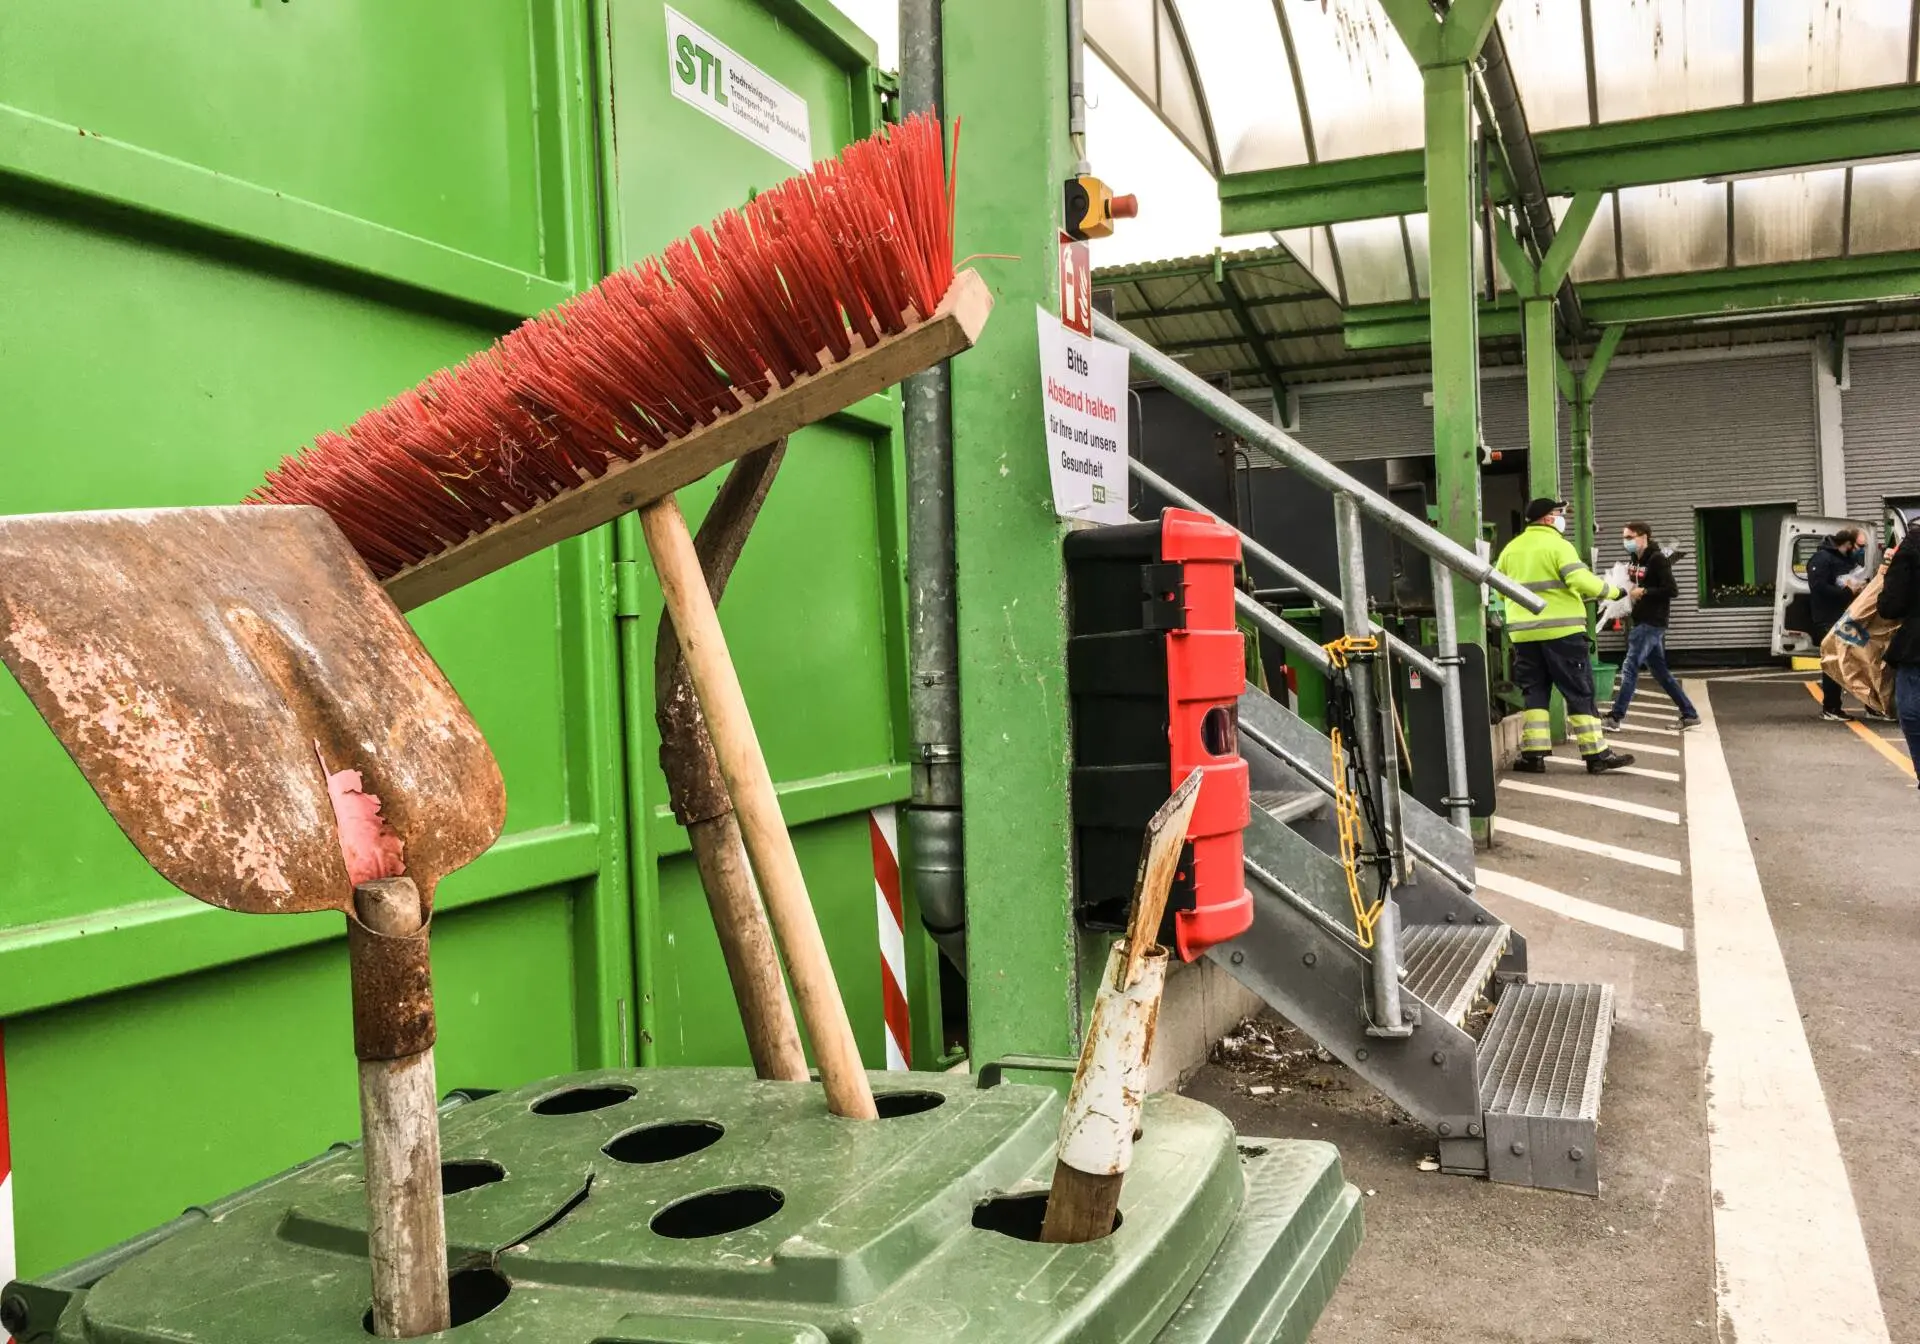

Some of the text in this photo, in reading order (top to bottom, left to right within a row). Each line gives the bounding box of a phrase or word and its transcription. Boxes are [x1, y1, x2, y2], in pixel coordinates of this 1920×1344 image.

[676, 34, 728, 107] STL
[731, 85, 762, 112] Transport-
[1068, 346, 1088, 376] Bitte
[1048, 375, 1116, 423] Abstand halten
[1050, 413, 1117, 453] für Ihre und unsere
[1061, 449, 1103, 479] Gesundheit
[1092, 487, 1105, 502] STL
